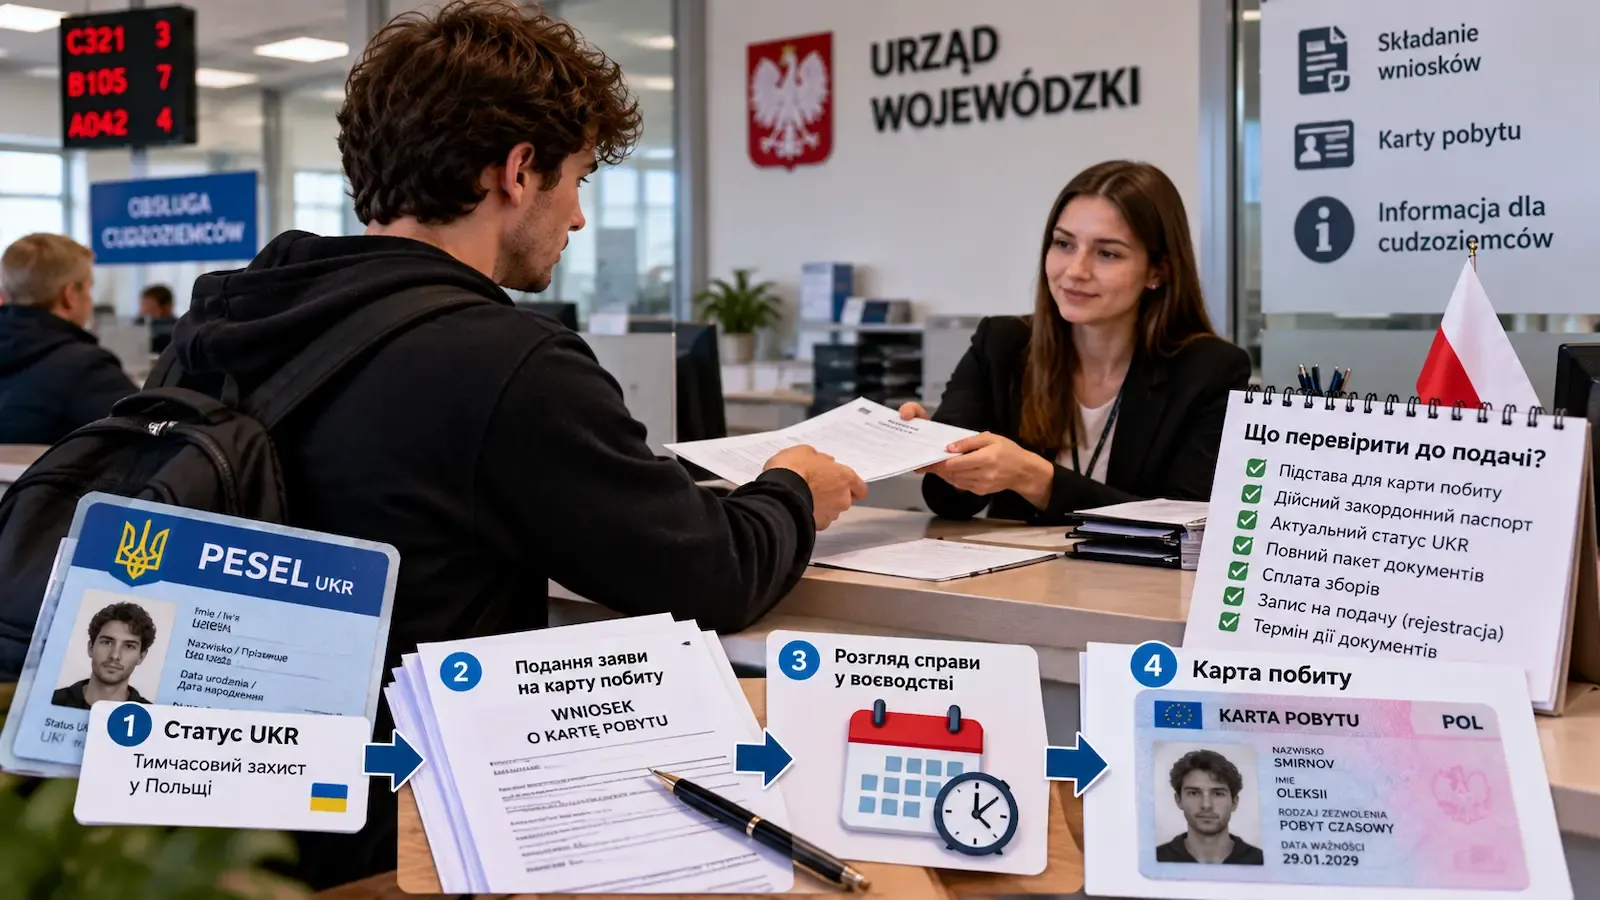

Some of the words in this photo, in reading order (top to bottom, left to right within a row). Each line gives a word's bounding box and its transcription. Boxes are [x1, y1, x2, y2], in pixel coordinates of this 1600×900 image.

[66, 26, 124, 55] C321
[156, 21, 170, 48] 3
[871, 26, 999, 77] URZĄD
[1379, 24, 1478, 51] Składanie
[68, 67, 127, 97] B105
[157, 64, 172, 89] 7
[1379, 53, 1481, 80] wniosków
[870, 66, 1140, 132] WOJEWÓDZKI
[69, 109, 128, 137] A042
[156, 107, 172, 131] 4
[1380, 129, 1435, 151] Karty
[1443, 123, 1520, 150] pobytu
[1380, 197, 1500, 224] Informacja
[1509, 196, 1545, 217] dla
[1378, 228, 1553, 252] cudzoziemców
[1245, 424, 1279, 445] Що
[1286, 432, 1409, 455] перевірити
[1415, 444, 1445, 461] до
[1453, 447, 1545, 468] подачі?
[1280, 464, 1347, 483] Підстава
[1352, 475, 1381, 487] для
[1388, 478, 1434, 493] карти
[1441, 483, 1502, 502] побиту
[1274, 491, 1339, 510] Дійсний
[1345, 502, 1454, 522] закордонний
[1461, 514, 1532, 533] паспорт
[1271, 517, 1366, 540] Актуальний
[1372, 532, 1426, 549] статус
[1433, 535, 1468, 552] UKR
[198, 543, 308, 588] PESEL
[316, 576, 353, 595] UKR
[1267, 542, 1327, 562] Повний
[1333, 554, 1380, 568] пакет
[1384, 561, 1483, 582] документів
[1263, 568, 1319, 587] Сплата
[1326, 578, 1379, 596] зборів
[1258, 593, 1306, 612] Запис
[1312, 604, 1330, 616] на
[1337, 608, 1397, 628] подачу
[1403, 613, 1503, 642] (rejestracja)
[186, 639, 232, 658] Nazwisko
[1254, 619, 1308, 639] Термін
[1313, 629, 1335, 644] дії
[1338, 635, 1436, 658] документів
[177, 681, 202, 691] Дата
[181, 670, 203, 680] Data
[551, 700, 634, 720] WNIOSEK
[1220, 709, 1280, 724] KARTA
[1286, 712, 1359, 727] POBYTU
[1443, 715, 1483, 730] POL
[528, 732, 540, 744] O
[545, 725, 600, 742] KARTĘ
[603, 715, 668, 733] POBYTU
[1273, 747, 1324, 755] NAZWISKO
[1275, 758, 1334, 768] SMIRNOV
[1277, 788, 1327, 798] OLEKSII
[1279, 808, 1318, 817] RODZAJ
[1322, 810, 1387, 819] ZEZWOLENIA
[1280, 820, 1324, 831] POBYT
[1329, 822, 1393, 833] CZASOWY
[1281, 841, 1308, 849] DATA
[1284, 853, 1359, 866] 29.01.2029
